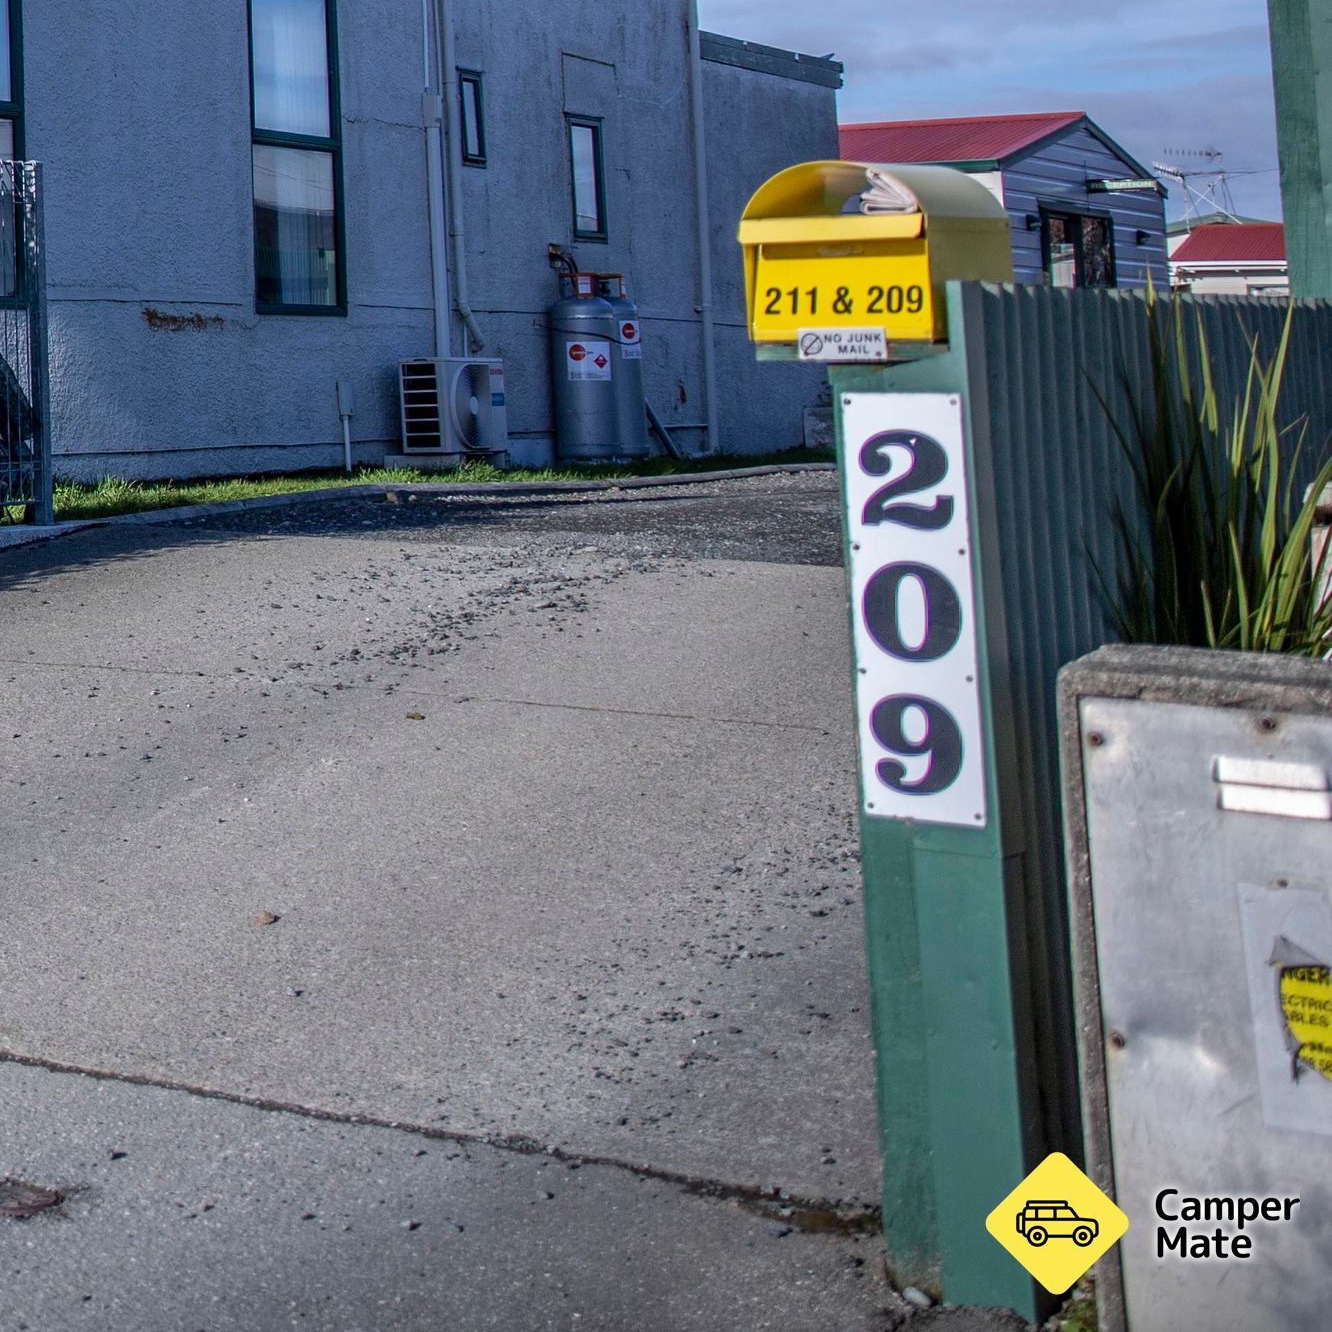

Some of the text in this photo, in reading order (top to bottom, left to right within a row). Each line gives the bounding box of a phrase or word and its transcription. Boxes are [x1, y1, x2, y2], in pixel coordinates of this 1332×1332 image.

[764, 285, 924, 315] 211 & 209
[824, 332, 882, 343] NO JUNK
[838, 344, 870, 354] MAIL
[858, 428, 963, 796] 209
